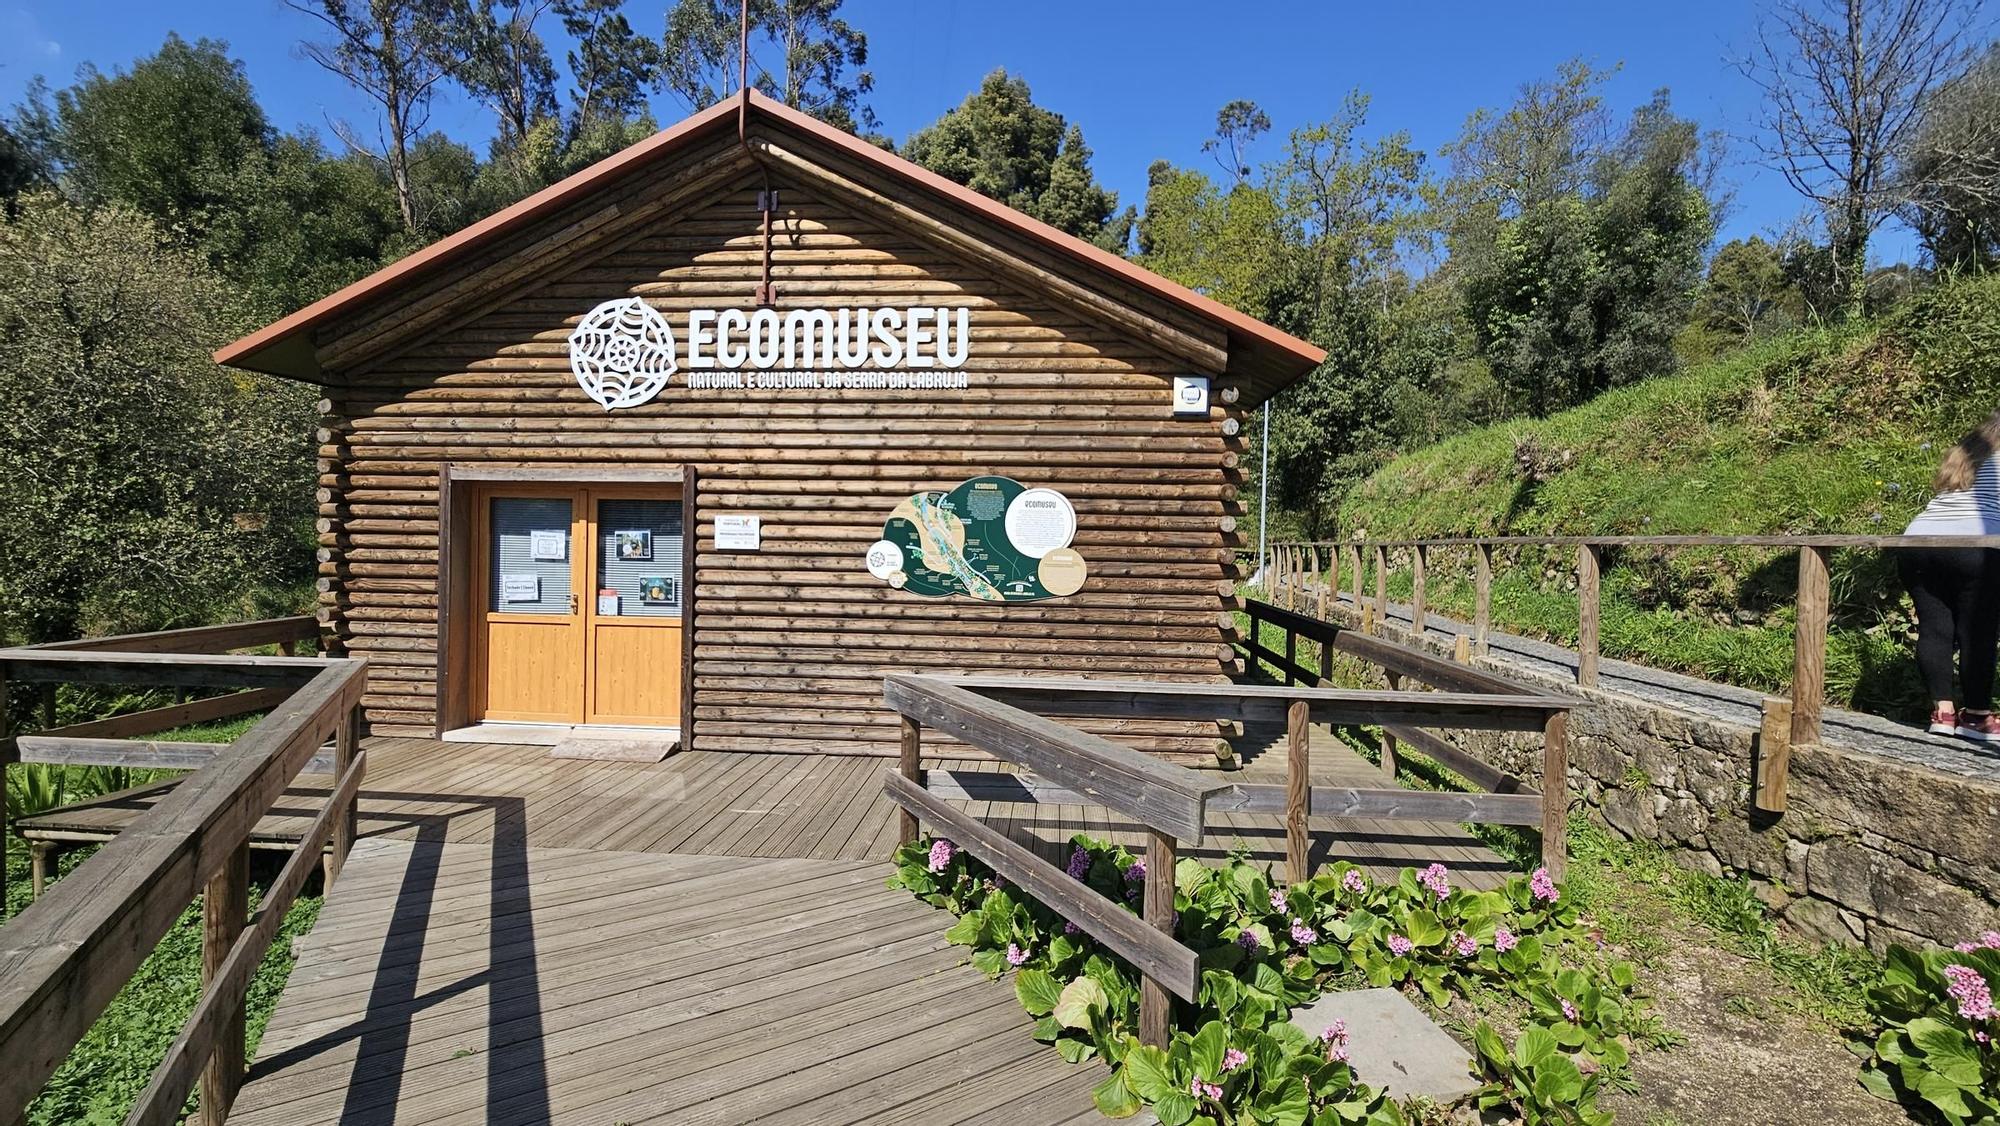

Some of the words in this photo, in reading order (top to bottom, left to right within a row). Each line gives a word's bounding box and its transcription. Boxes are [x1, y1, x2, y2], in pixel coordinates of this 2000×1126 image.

[688, 308, 969, 368] ECOMUSEU
[688, 371, 744, 388] NATURAL
[747, 371, 755, 388] E
[757, 371, 821, 388] CULTURAL
[824, 371, 841, 388] DA
[844, 371, 886, 388] SERRA
[888, 371, 906, 388] DA
[908, 371, 968, 388] LABRUJA
